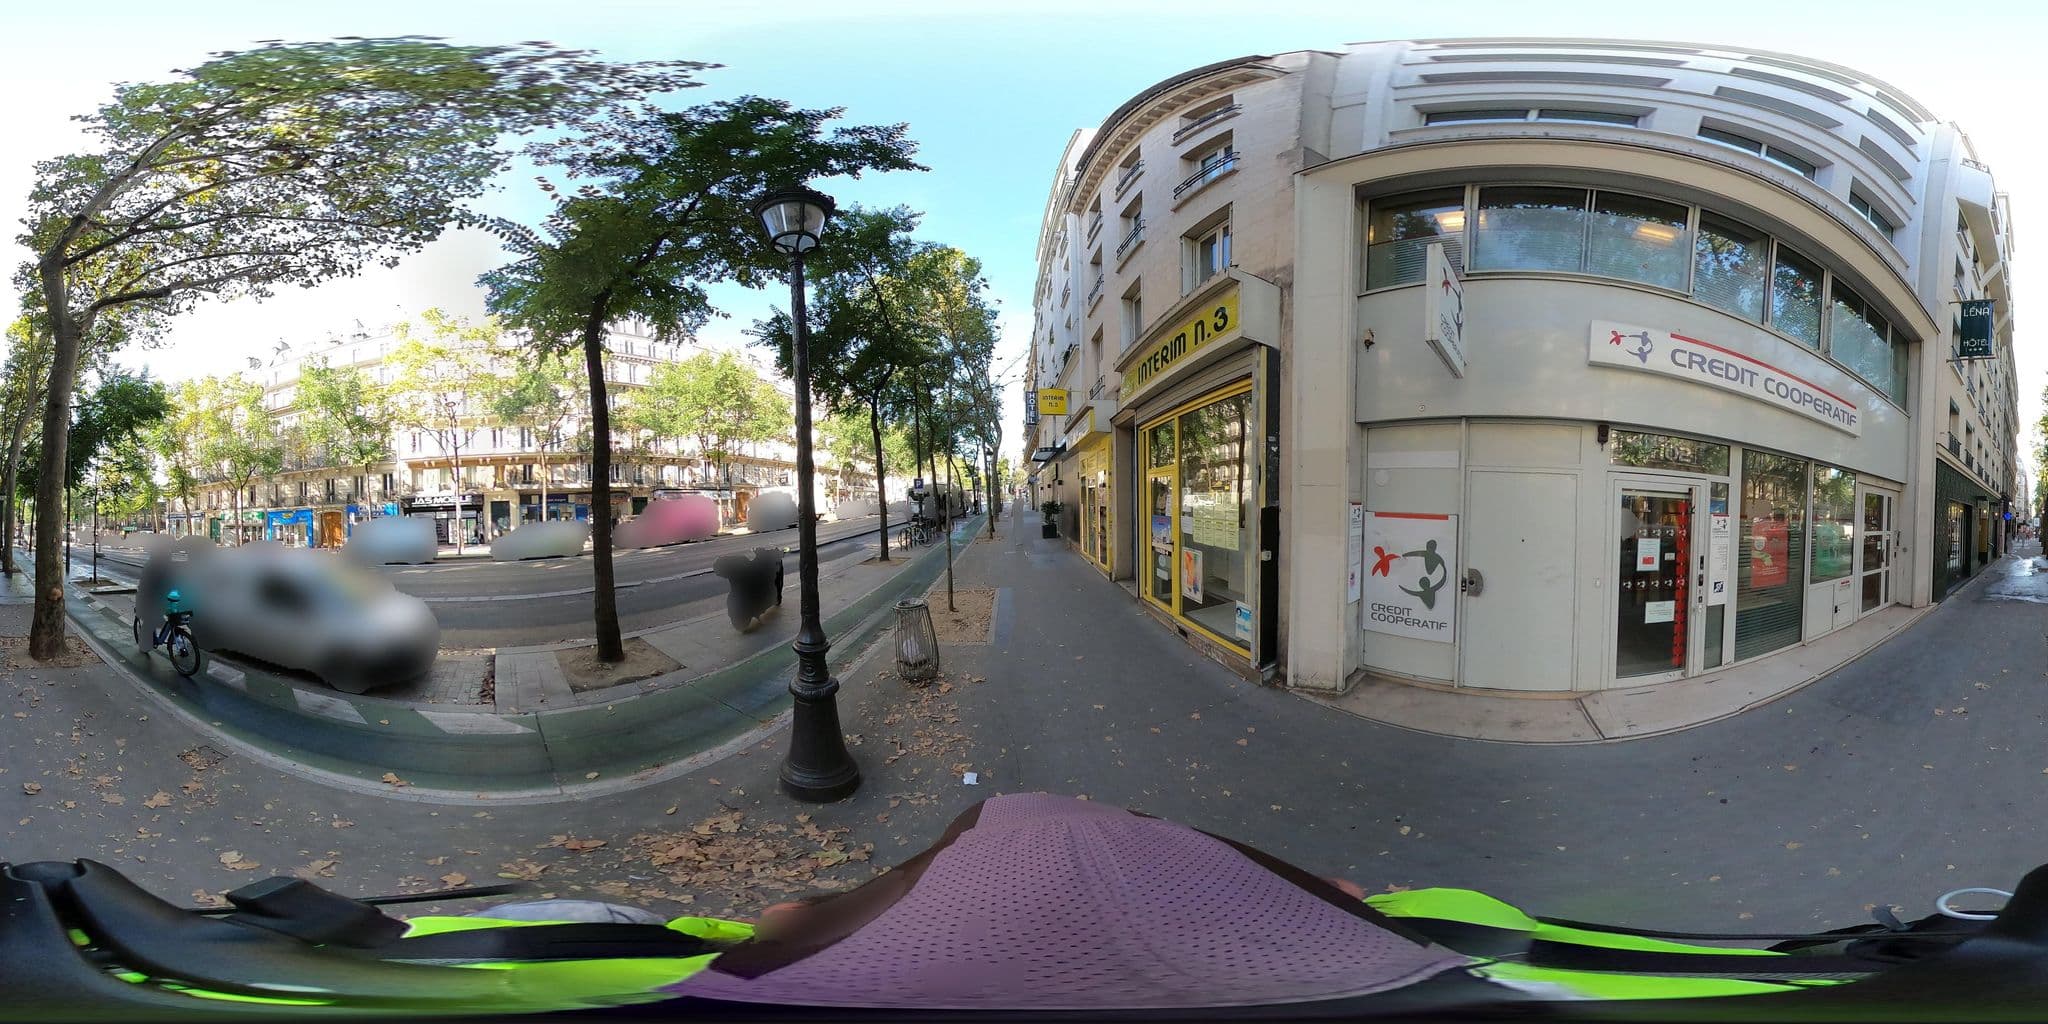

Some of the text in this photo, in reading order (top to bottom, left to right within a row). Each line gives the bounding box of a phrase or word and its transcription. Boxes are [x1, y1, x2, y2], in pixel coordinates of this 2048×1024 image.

[1963, 306, 1990, 317] LÉNA
[1138, 332, 1186, 385] INTERIM
[1671, 348, 1857, 427] CREDIT COOPERATIF
[433, 495, 473, 505] MOBLE
[1371, 603, 1412, 617] CREDIT
[1370, 612, 1448, 631] COOPERATIF
